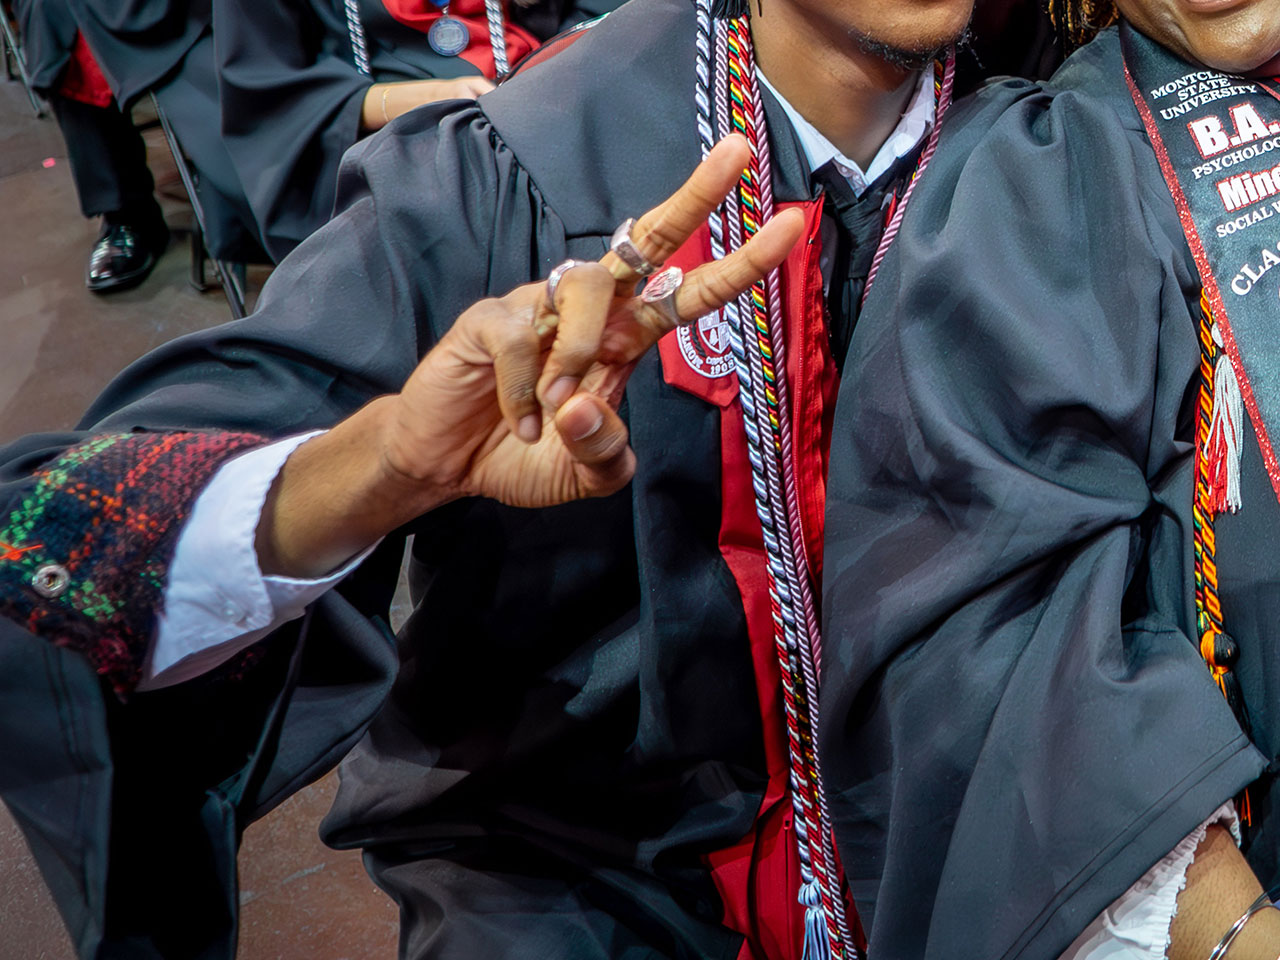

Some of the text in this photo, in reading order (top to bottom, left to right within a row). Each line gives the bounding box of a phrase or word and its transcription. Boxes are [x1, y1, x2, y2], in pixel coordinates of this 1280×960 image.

[1150, 70, 1245, 100] MONTCLA
[1177, 77, 1231, 102] STATE
[1160, 84, 1257, 120] UNIVERSITY
[1215, 205, 1273, 238] SOCIAL
